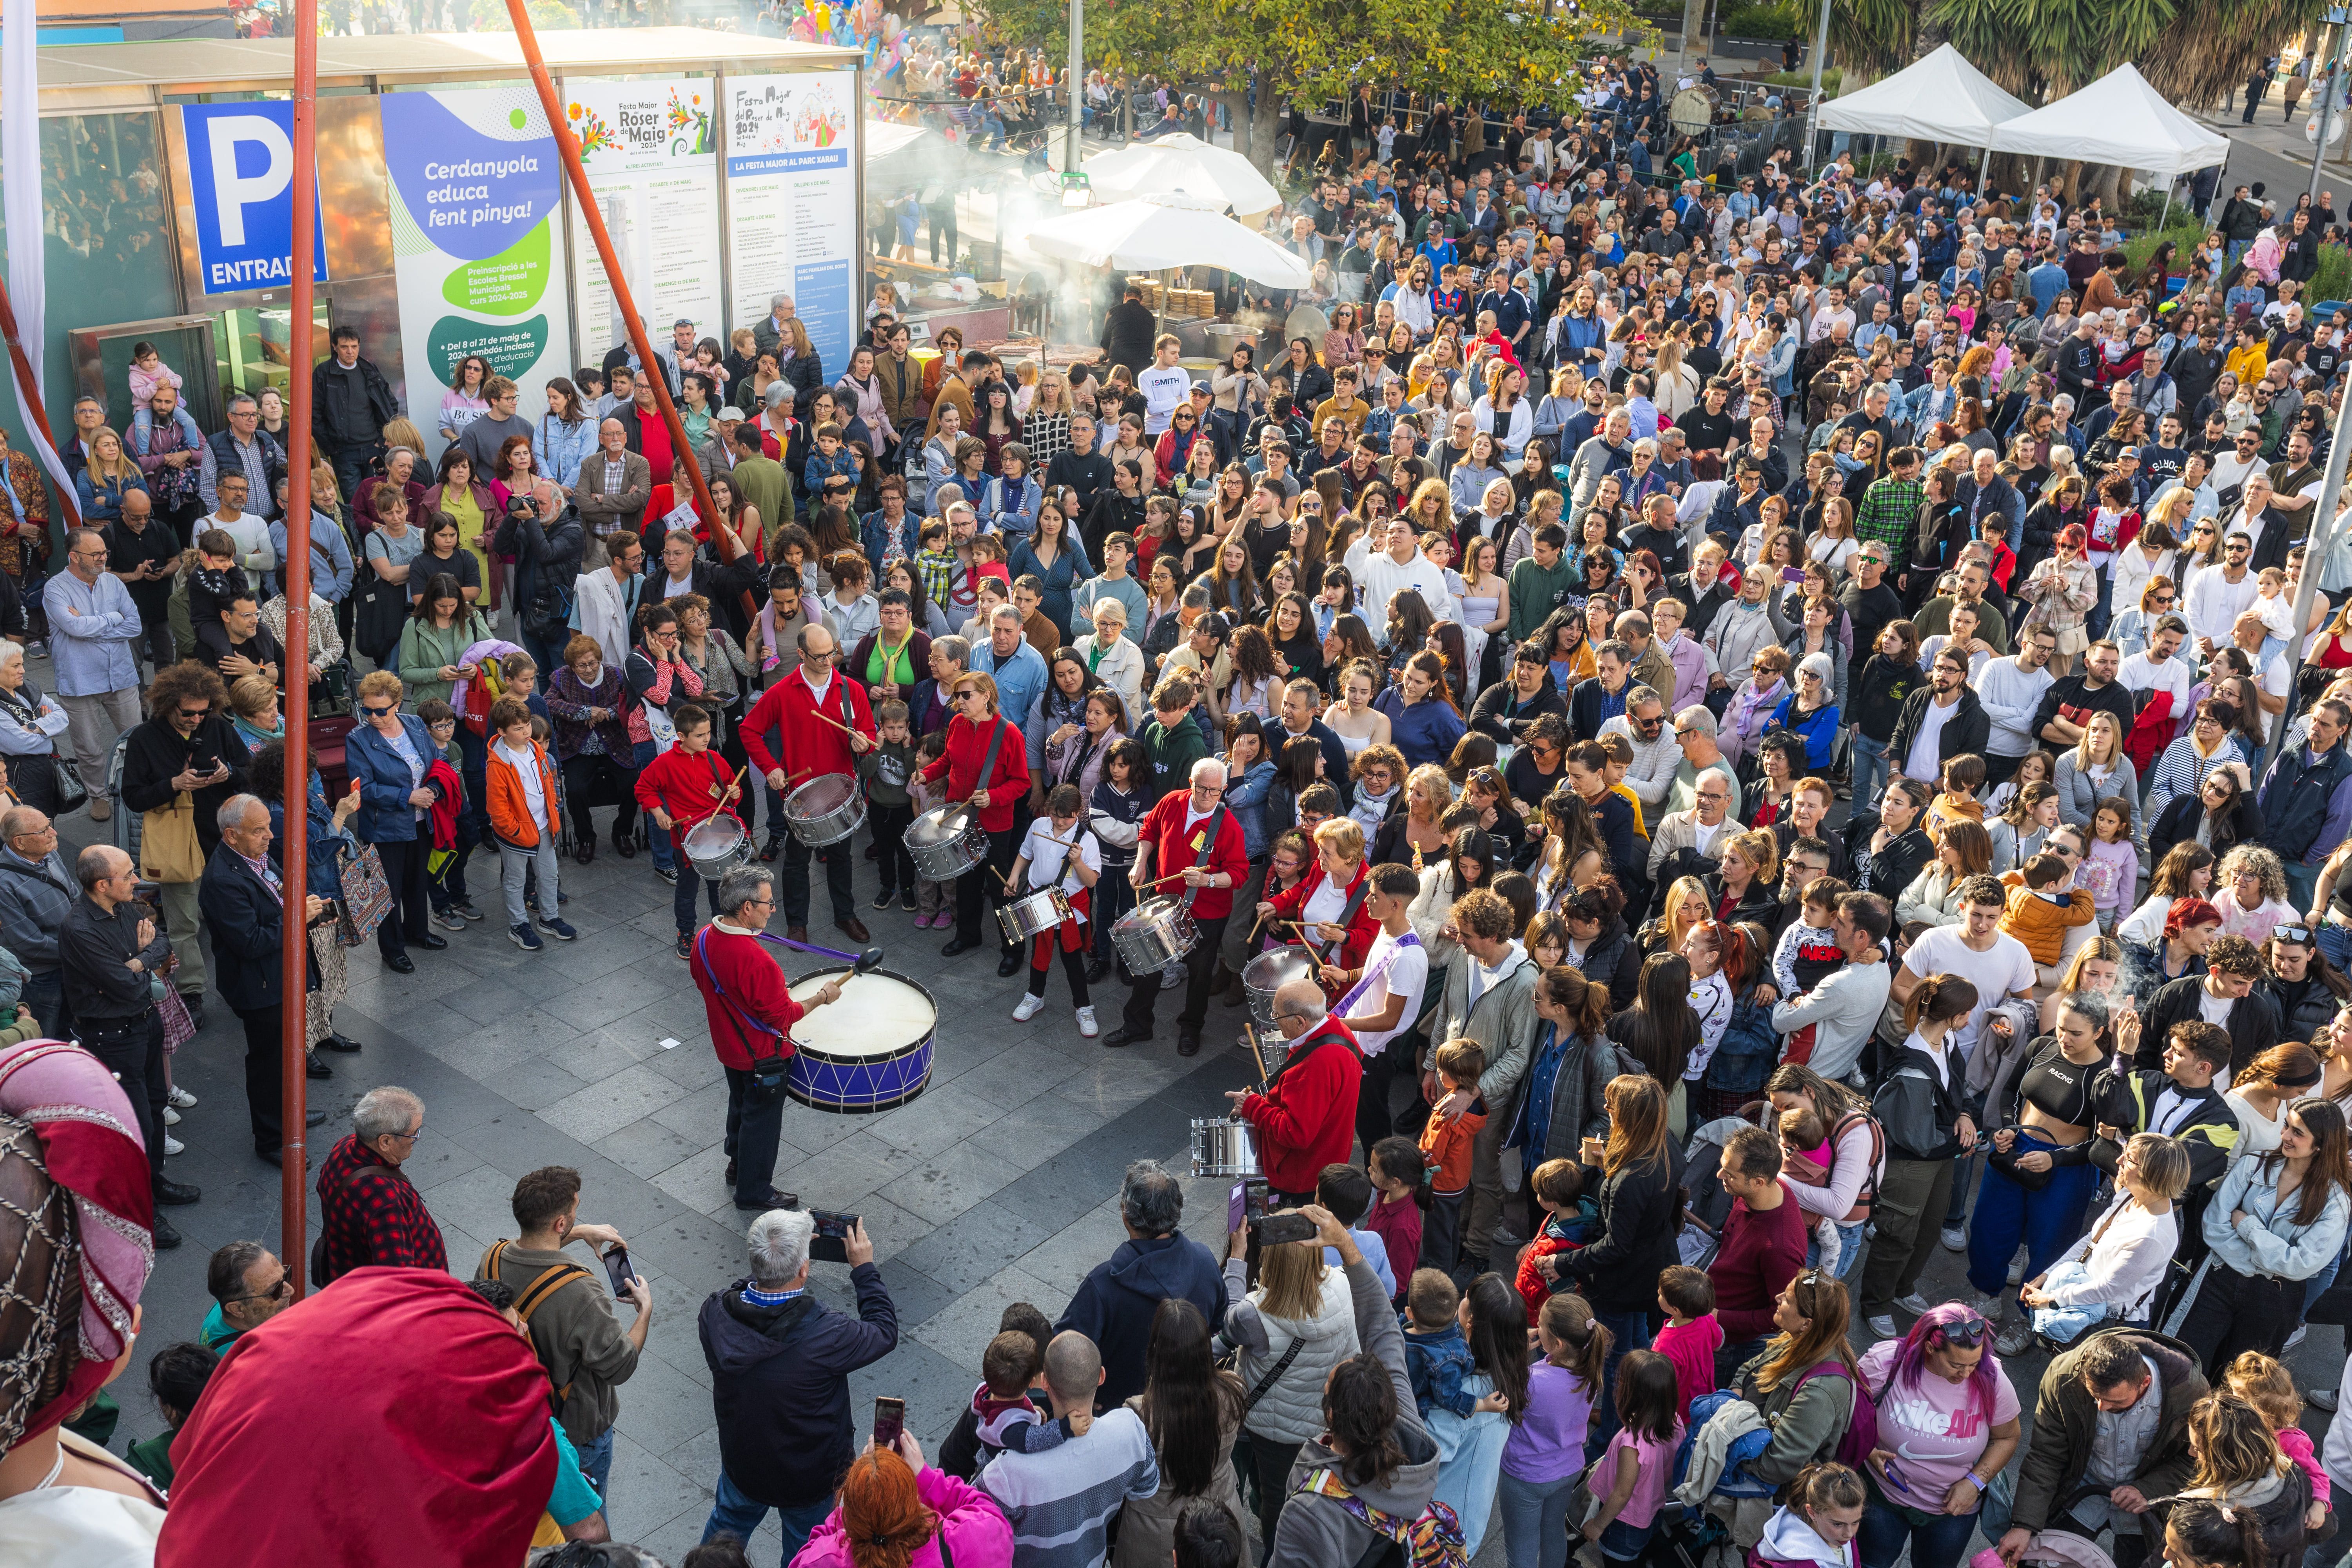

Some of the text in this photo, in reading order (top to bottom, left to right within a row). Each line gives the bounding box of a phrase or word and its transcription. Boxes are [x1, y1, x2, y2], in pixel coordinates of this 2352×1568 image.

[766, 86, 791, 103] Major
[620, 111, 659, 127] Roser
[736, 107, 790, 122] del Roser de Maig
[629, 126, 665, 143] Maig
[736, 122, 759, 135] 2024
[425, 155, 538, 180] Cerdanyola
[746, 161, 765, 170] FESTA
[766, 160, 787, 168] MAJOR
[817, 155, 838, 163] XARAU
[207, 116, 293, 247] P
[427, 184, 488, 204] educa
[429, 201, 532, 227] fent pinya!
[468, 262, 518, 276] Preinscripció
[468, 272, 527, 286] Escoles Bressol
[469, 283, 511, 295] Municipals
[470, 291, 527, 305] curs 2024-2025
[447, 341, 461, 351] Del
[499, 333, 519, 343] maig
[471, 347, 503, 356] ambdós
[505, 341, 535, 352] inclosos
[495, 350, 534, 363] d'educació
[494, 363, 514, 372] anys)
[1155, 377, 1179, 386] SMITH
[1129, 806, 1139, 817] Y
[2102, 866, 2112, 898] TOGETHER
[2048, 1068, 2074, 1084] RACING
[1280, 1337, 1304, 1365] BIMBA
[1261, 1367, 1284, 1388] BIMBA
[1905, 1427, 1935, 1439] Higher
